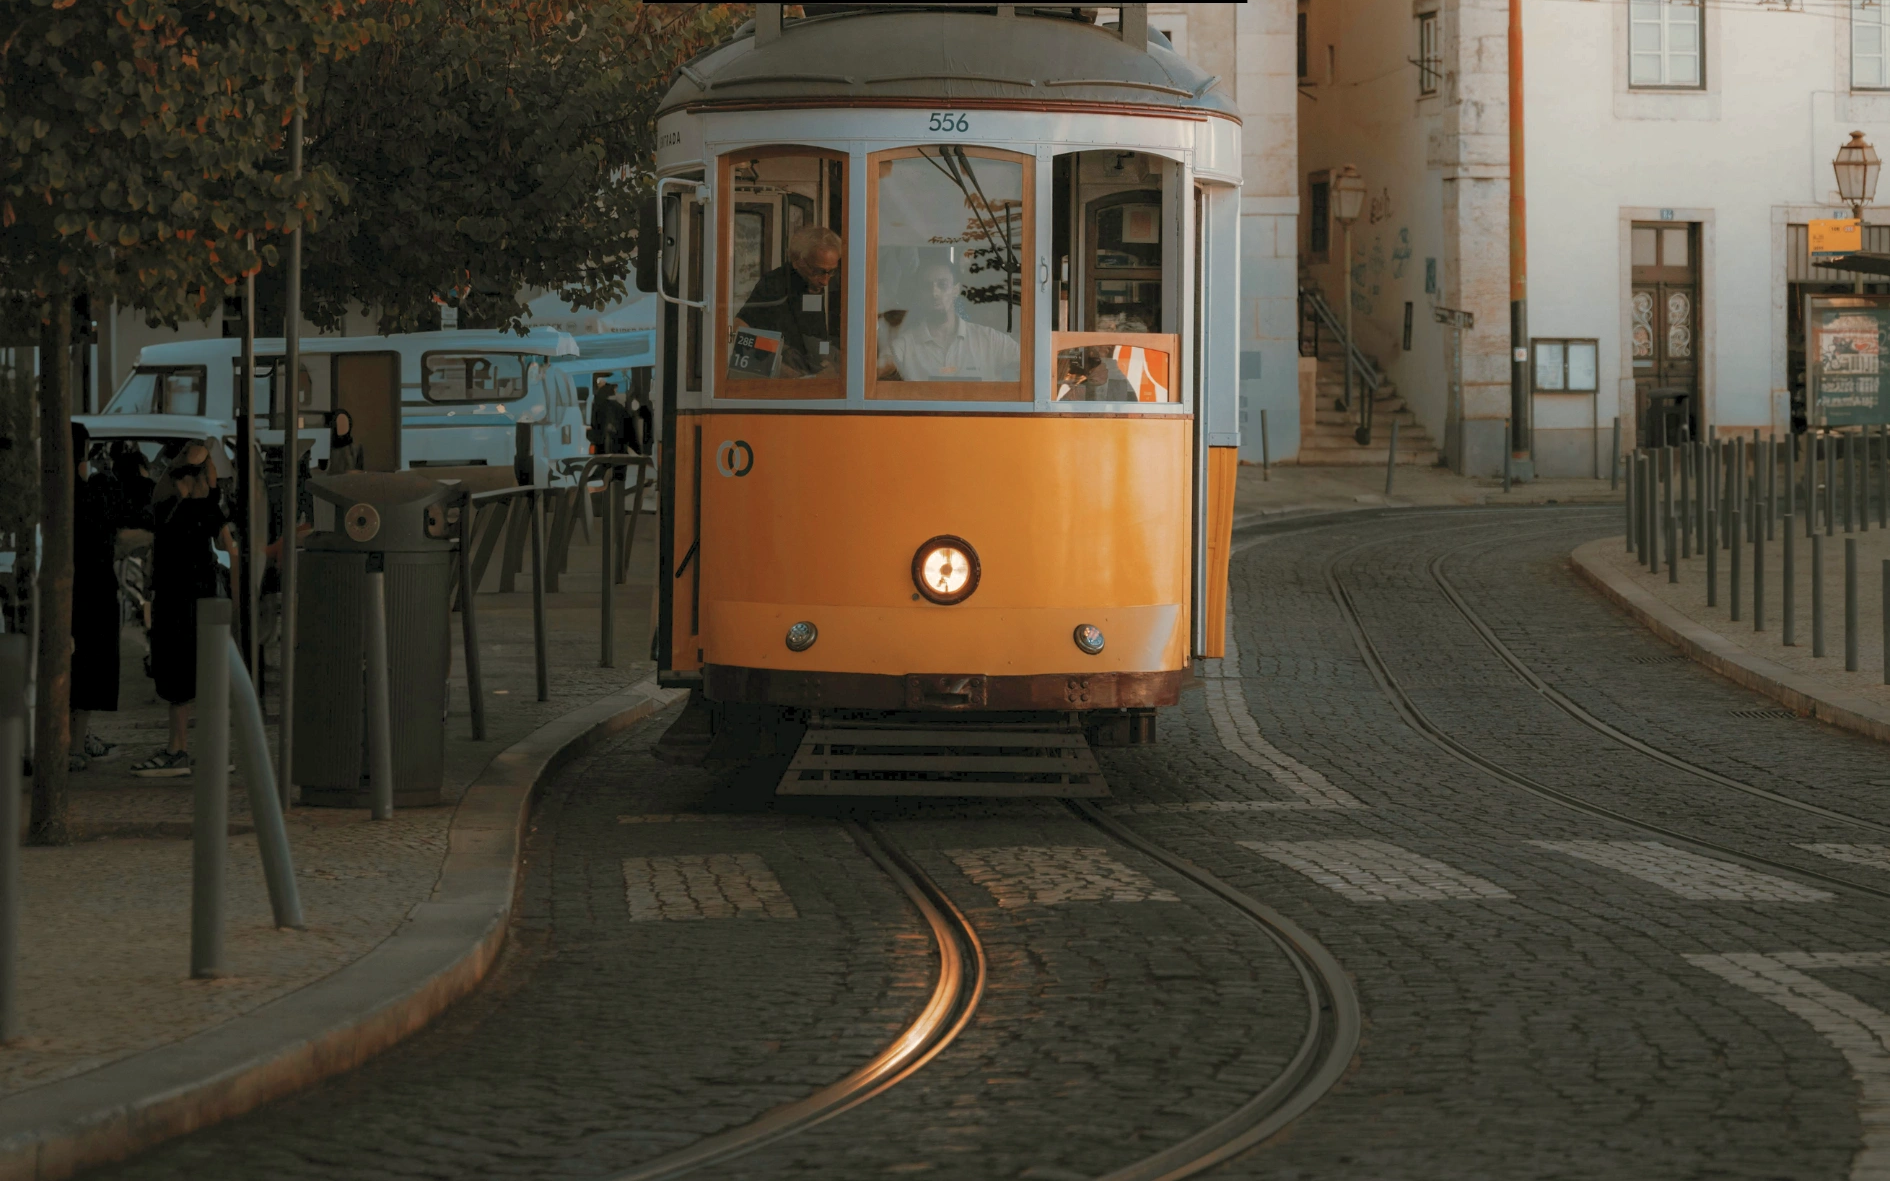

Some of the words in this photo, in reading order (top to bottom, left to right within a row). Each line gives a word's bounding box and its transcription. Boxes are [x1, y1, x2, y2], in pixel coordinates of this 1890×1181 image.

[929, 112, 969, 132] 556
[737, 335, 755, 348] 28E
[734, 353, 750, 368] 16
